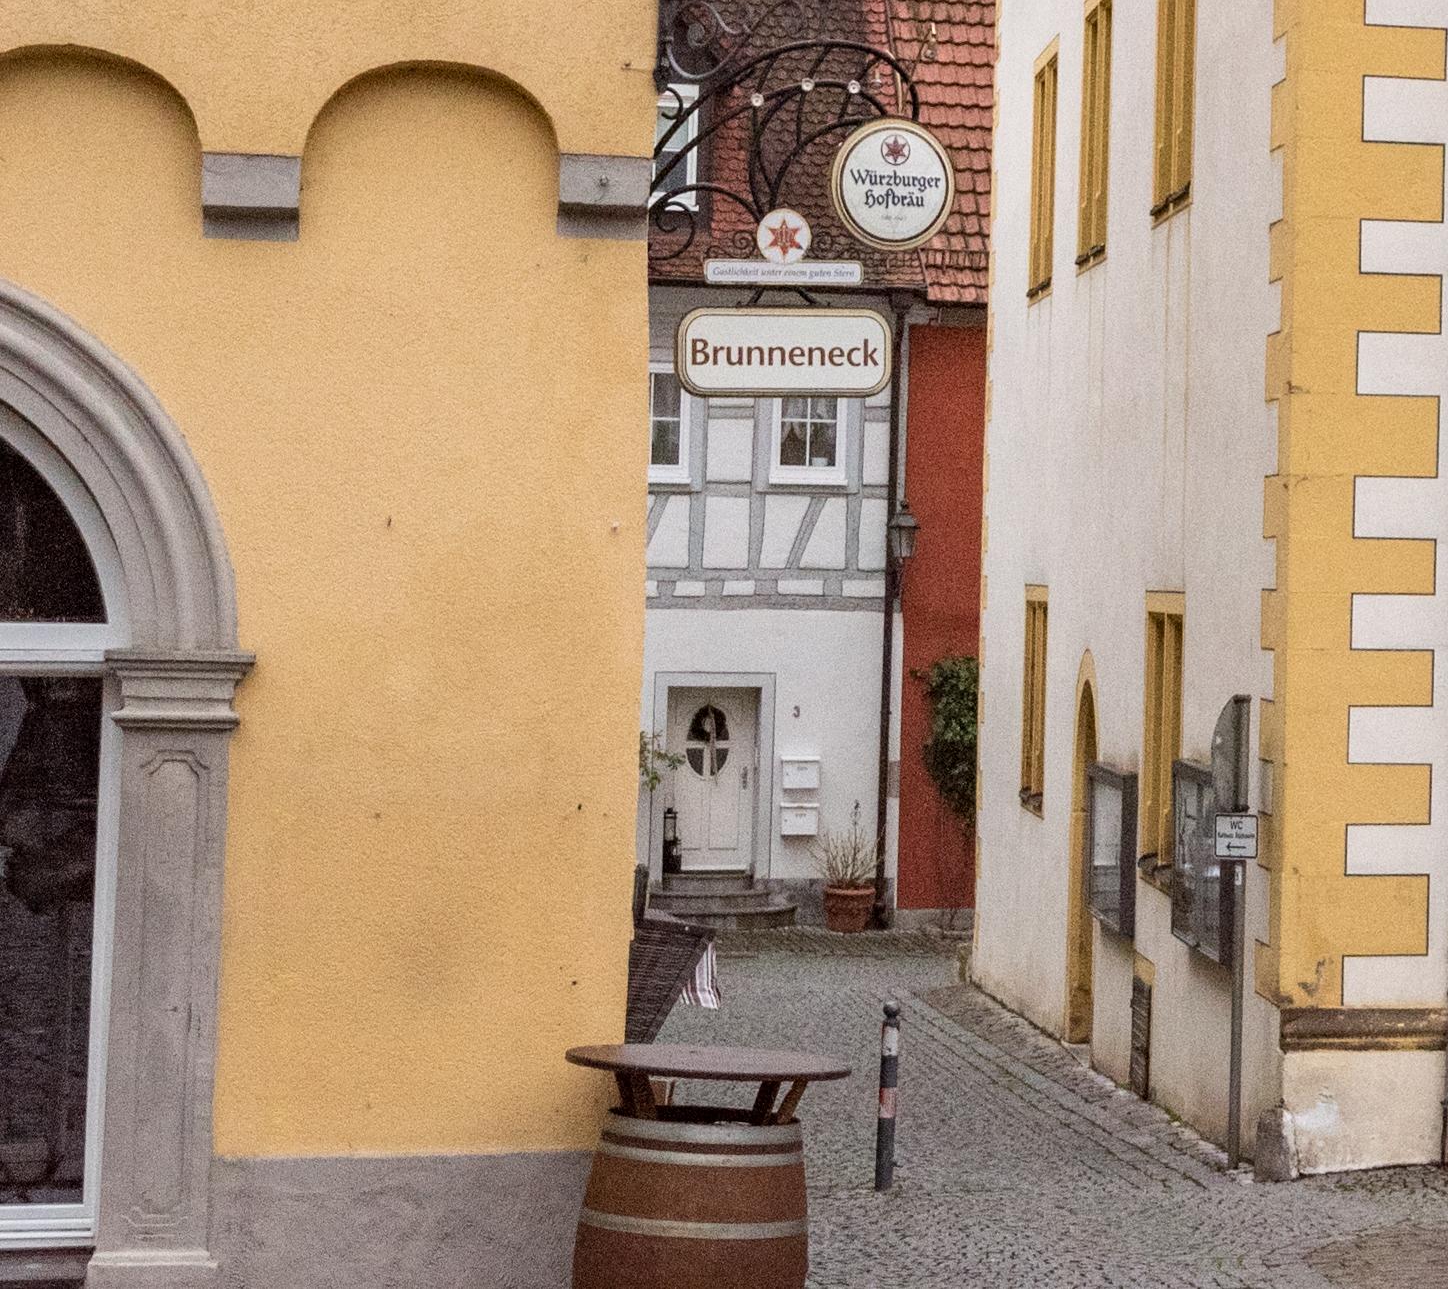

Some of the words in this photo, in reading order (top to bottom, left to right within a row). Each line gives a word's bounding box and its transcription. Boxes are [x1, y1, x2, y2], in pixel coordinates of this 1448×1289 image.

[850, 168, 941, 192] Würzburger
[864, 188, 924, 209] Hofbräu
[691, 338, 879, 367] Brunneneck
[792, 705, 801, 719] 3
[1230, 820, 1244, 830] WC
